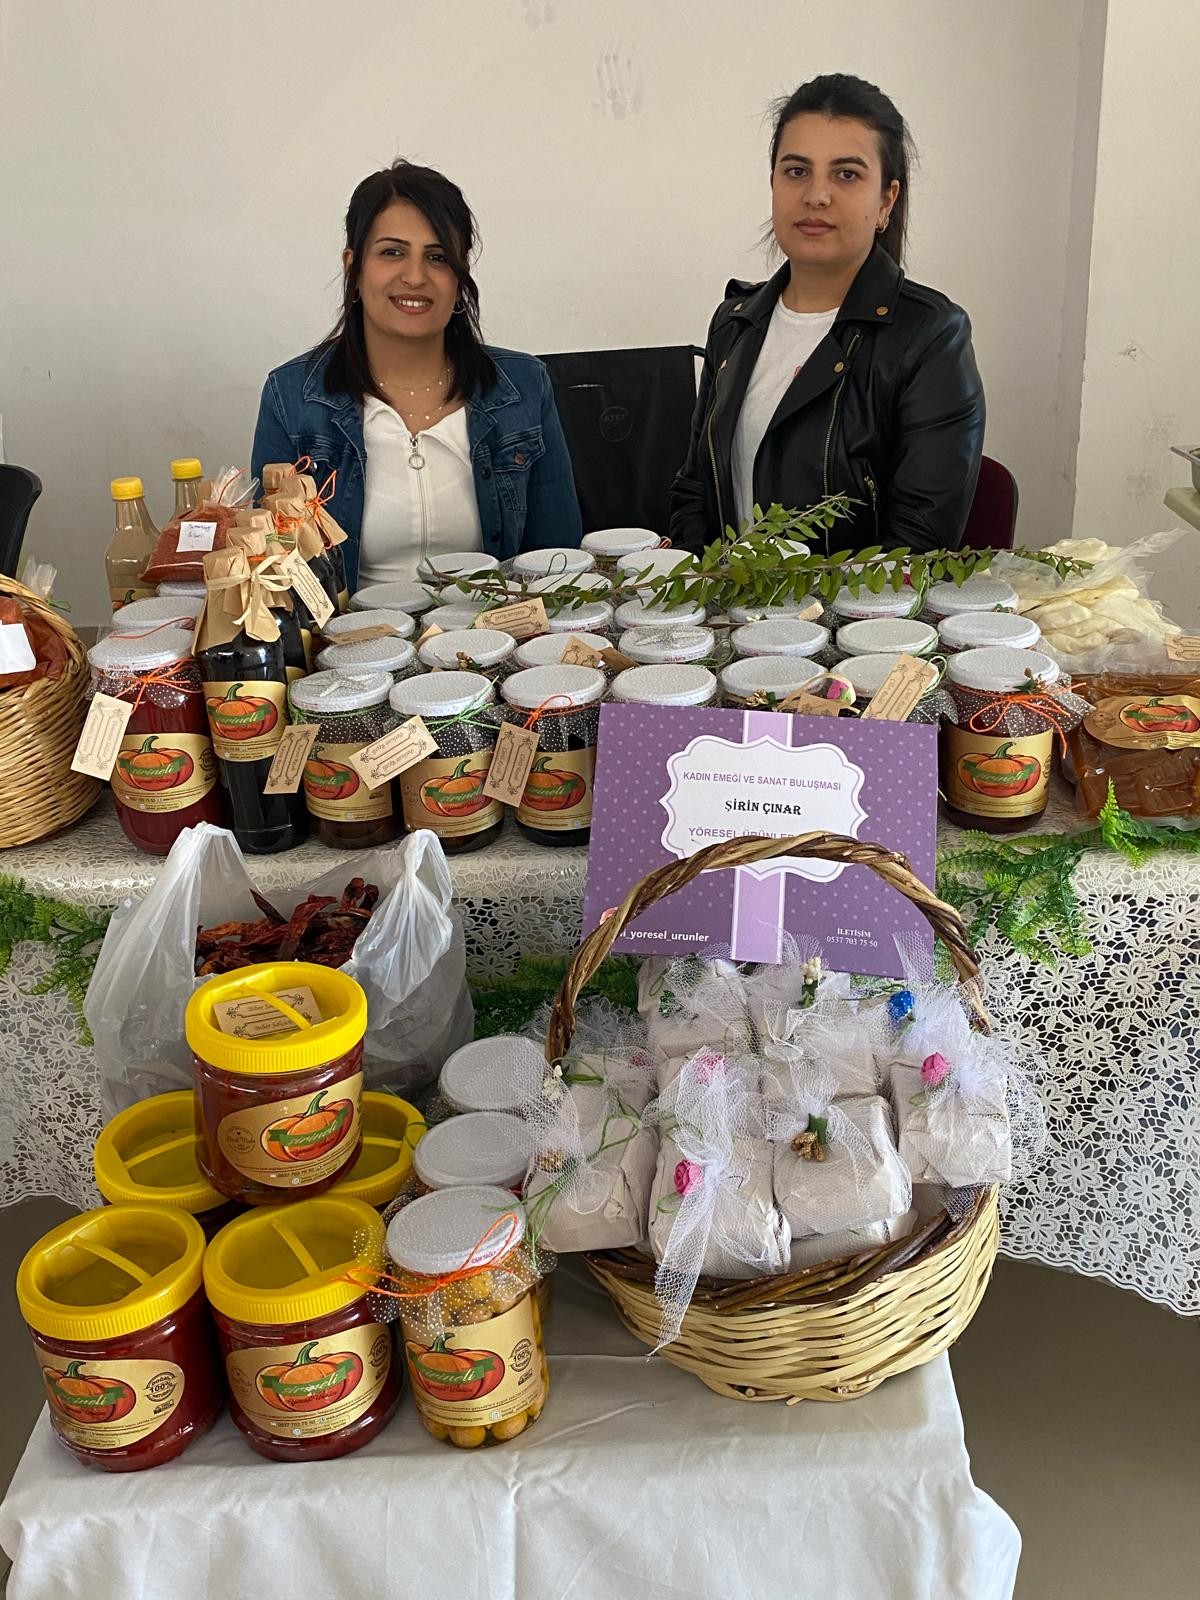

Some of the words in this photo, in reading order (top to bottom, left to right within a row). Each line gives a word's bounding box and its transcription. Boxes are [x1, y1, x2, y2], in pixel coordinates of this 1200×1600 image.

[683, 771, 711, 781] KADIN
[713, 772, 741, 783] EMEĞİ
[743, 775, 755, 784] VE
[757, 776, 787, 786] SANAT
[789, 778, 841, 791] BULUŞMASI
[724, 798, 760, 812] ŞİRİN
[762, 802, 802, 815] ÇINAR
[688, 826, 737, 838] YÖRESEL
[826, 935, 844, 943] 0537
[845, 937, 858, 946] 703
[869, 940, 878, 948] 50
[150, 1380, 173, 1393] 100%
